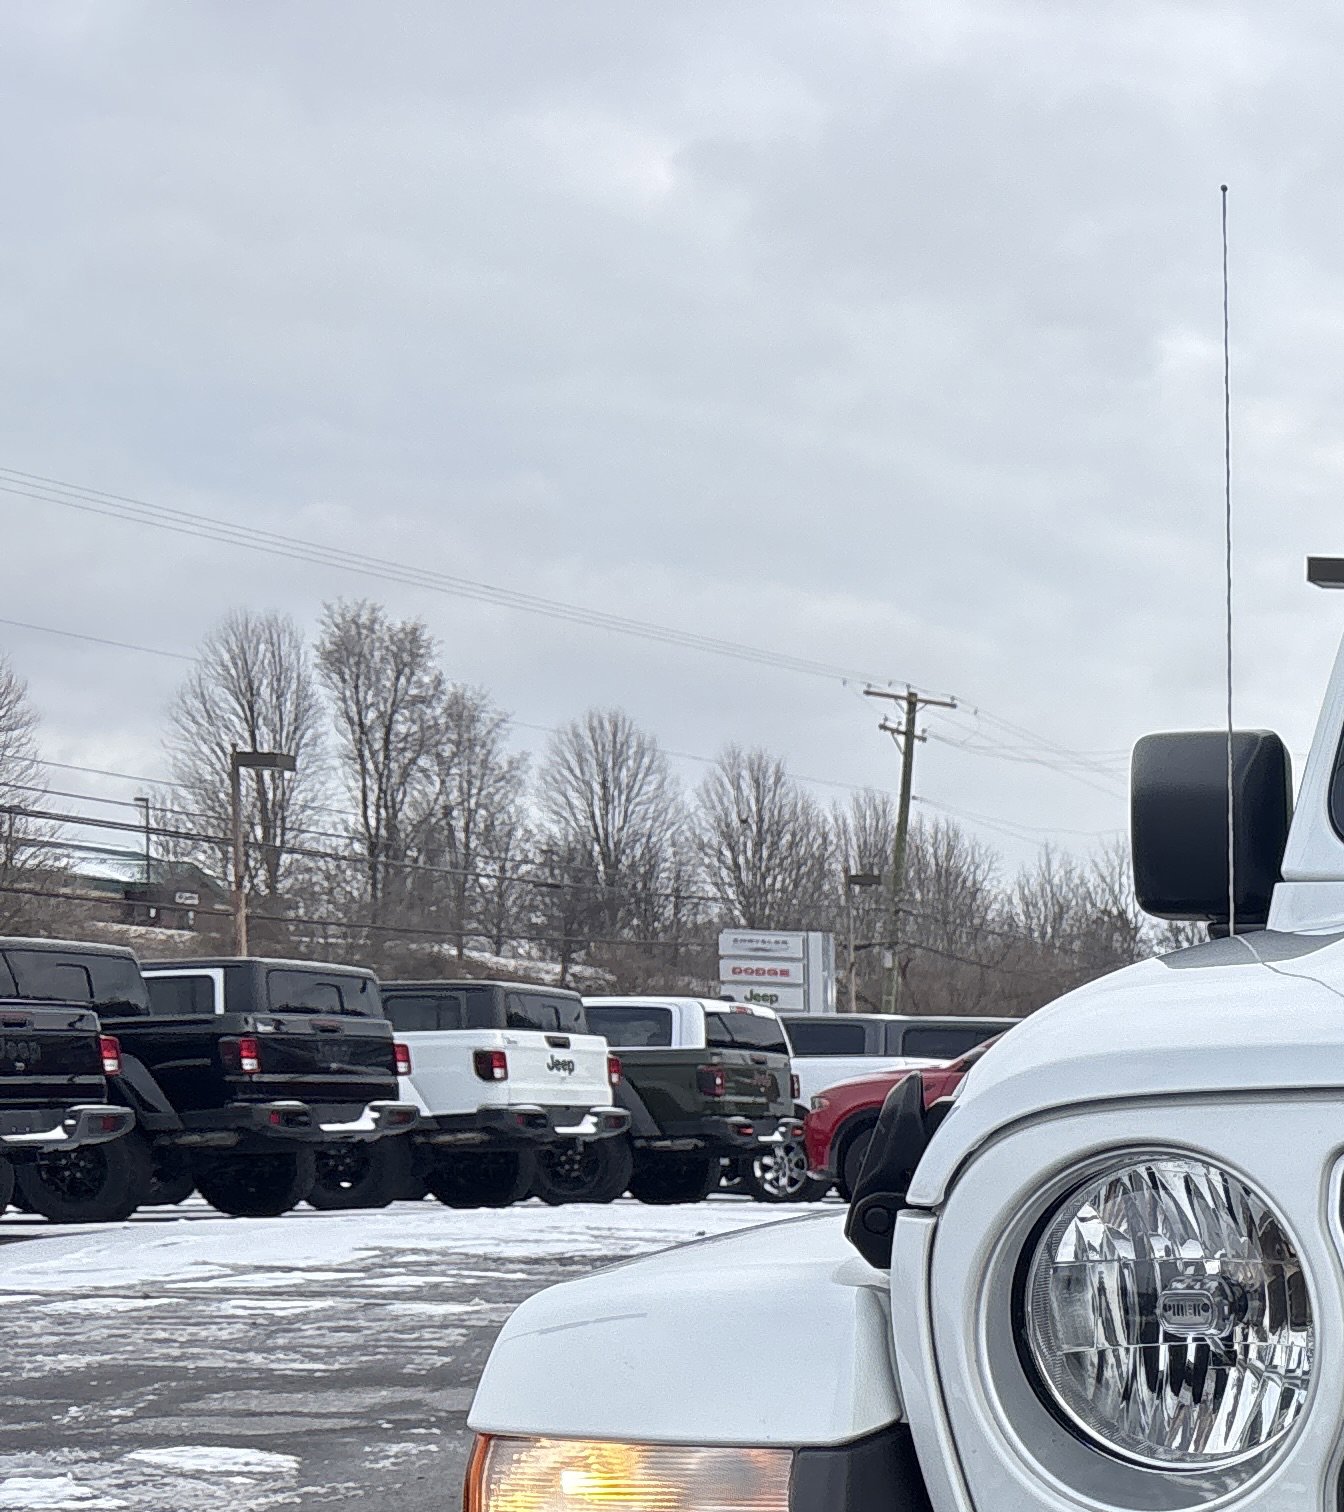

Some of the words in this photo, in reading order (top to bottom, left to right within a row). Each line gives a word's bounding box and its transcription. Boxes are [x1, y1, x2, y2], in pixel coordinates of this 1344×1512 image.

[731, 966, 790, 978] DODGE
[743, 988, 779, 1005] Jeep
[546, 1054, 576, 1076] Jeep
